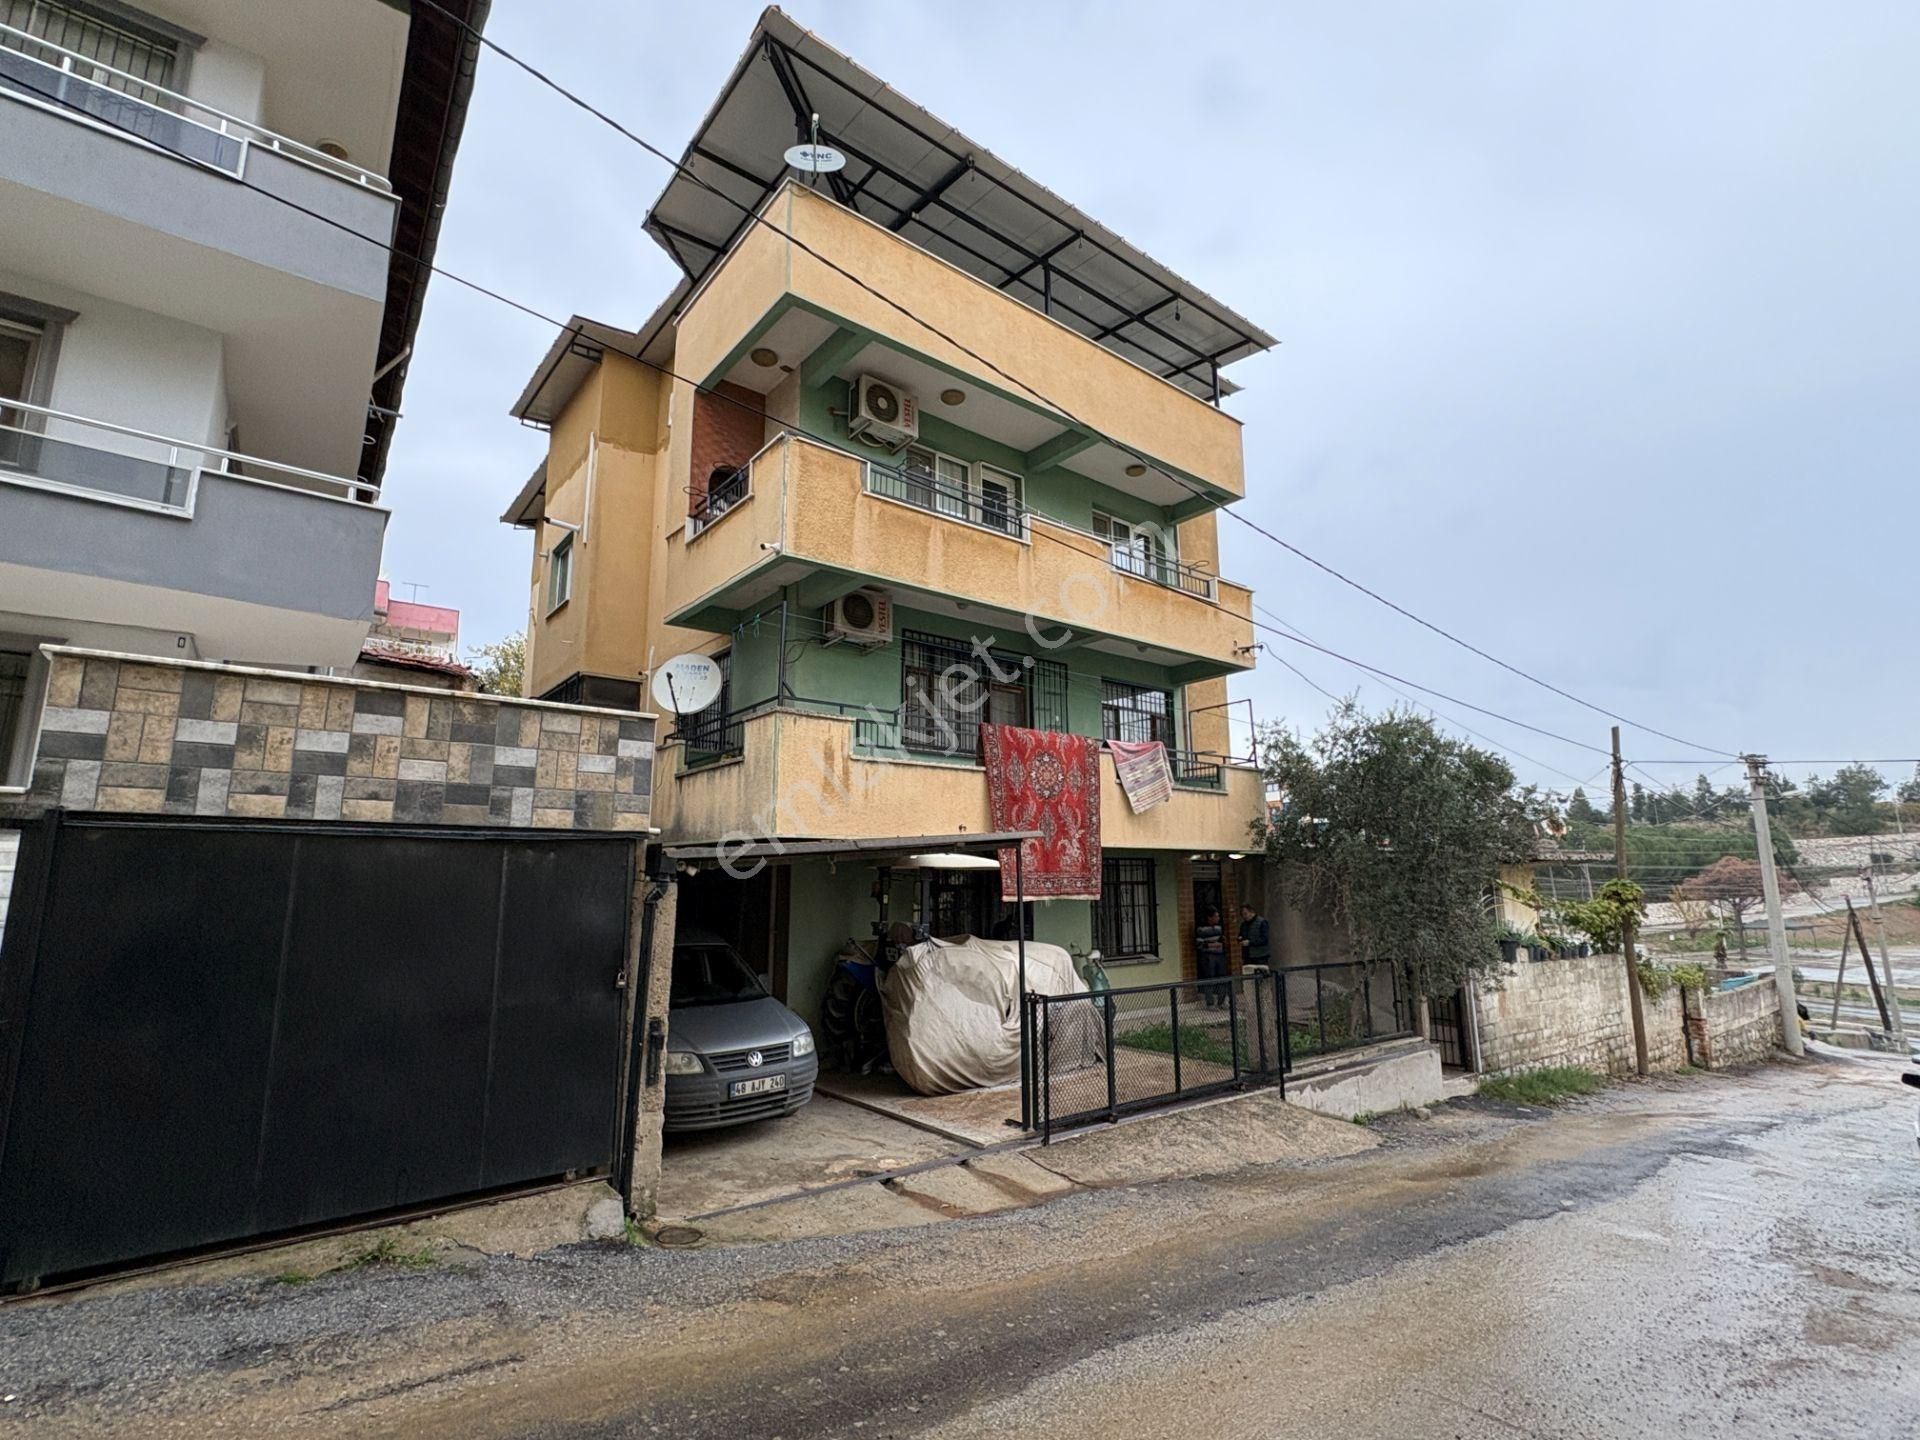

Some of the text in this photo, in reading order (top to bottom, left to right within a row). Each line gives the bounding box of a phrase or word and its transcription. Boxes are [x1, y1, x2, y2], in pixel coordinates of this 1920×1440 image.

[878, 599, 887, 634] VESTEL
[750, 1079, 766, 1092] AJY
[769, 1075, 785, 1089] 240
